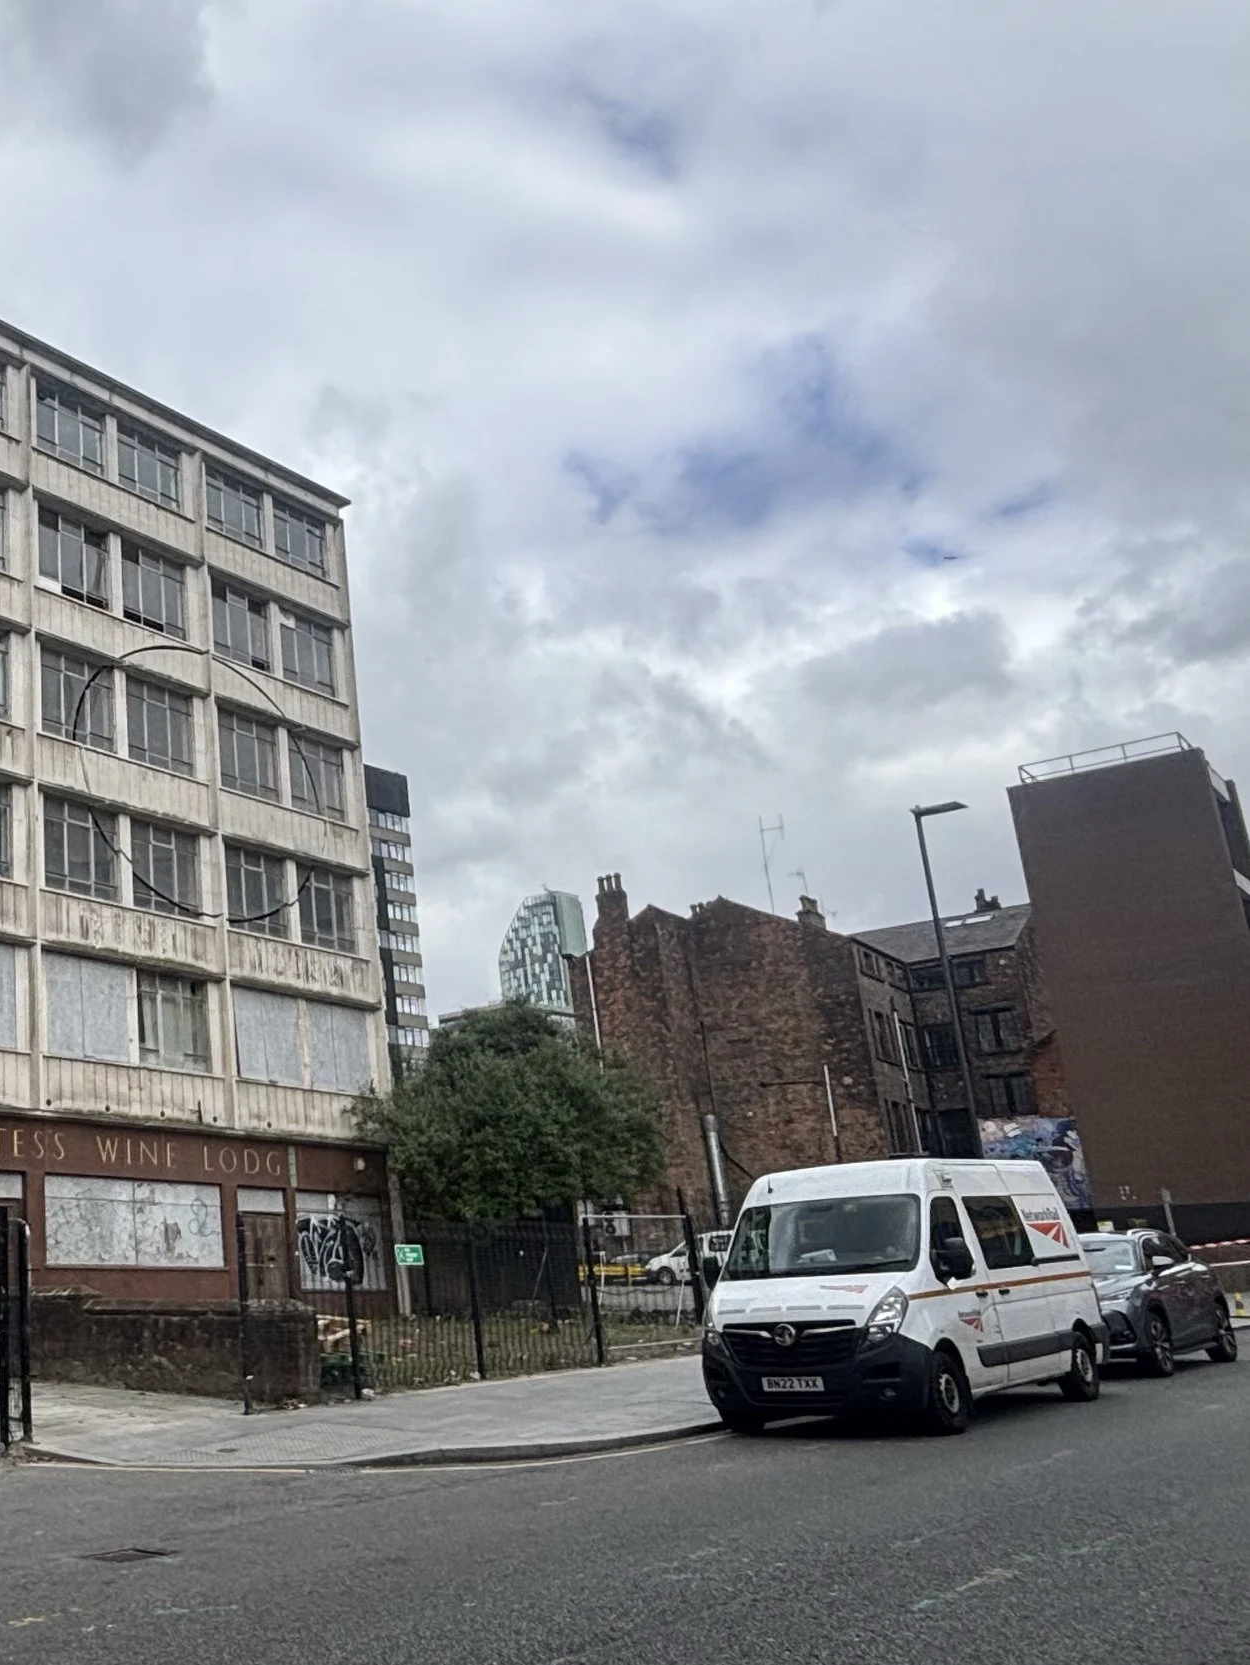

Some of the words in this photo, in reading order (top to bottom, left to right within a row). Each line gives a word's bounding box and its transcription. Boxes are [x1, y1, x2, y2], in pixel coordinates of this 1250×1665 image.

[96, 1135, 178, 1168] WINE
[203, 1145, 281, 1176] LODG
[766, 1378, 795, 1389] BN22
[796, 1378, 820, 1389] TXX
